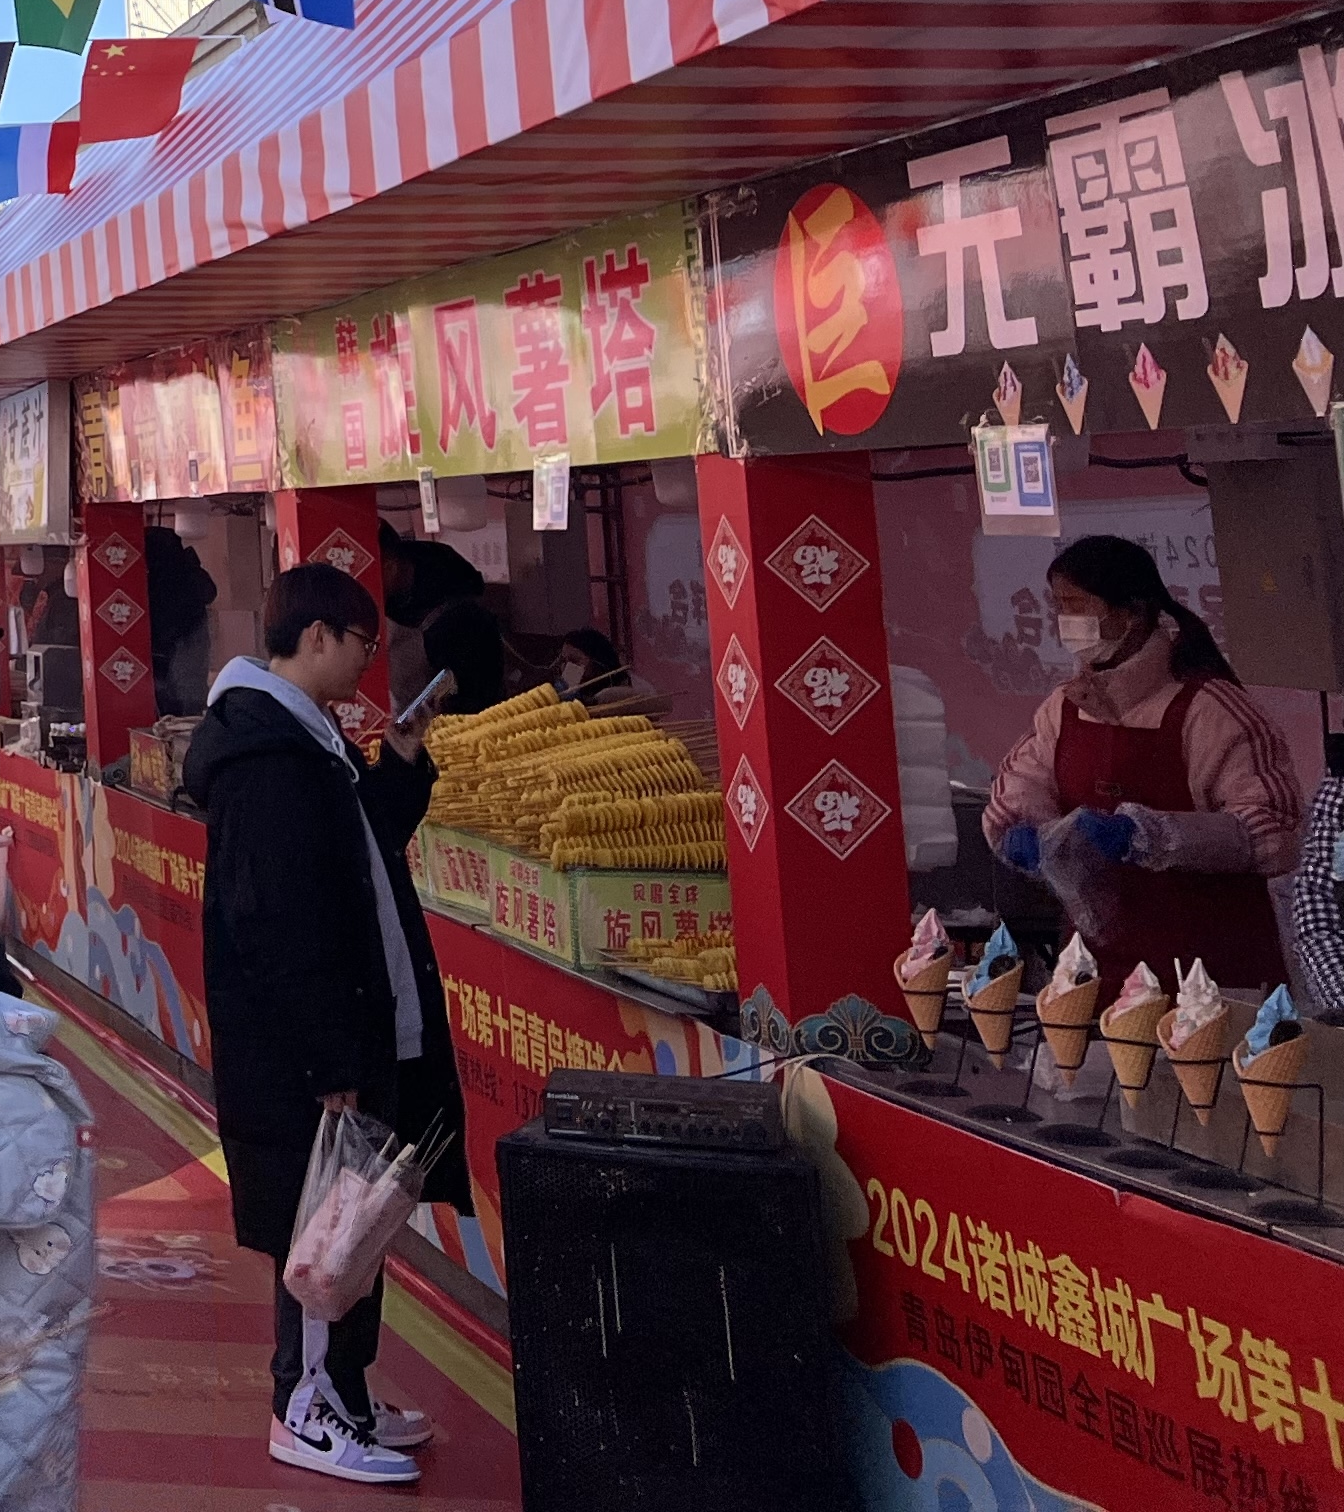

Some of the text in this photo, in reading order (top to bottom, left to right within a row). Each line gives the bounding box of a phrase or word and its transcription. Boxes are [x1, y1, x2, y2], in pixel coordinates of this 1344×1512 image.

[370, 242, 656, 460] 旋风薯塔
[443, 973, 625, 1078] 广场第十届青岛糖球
